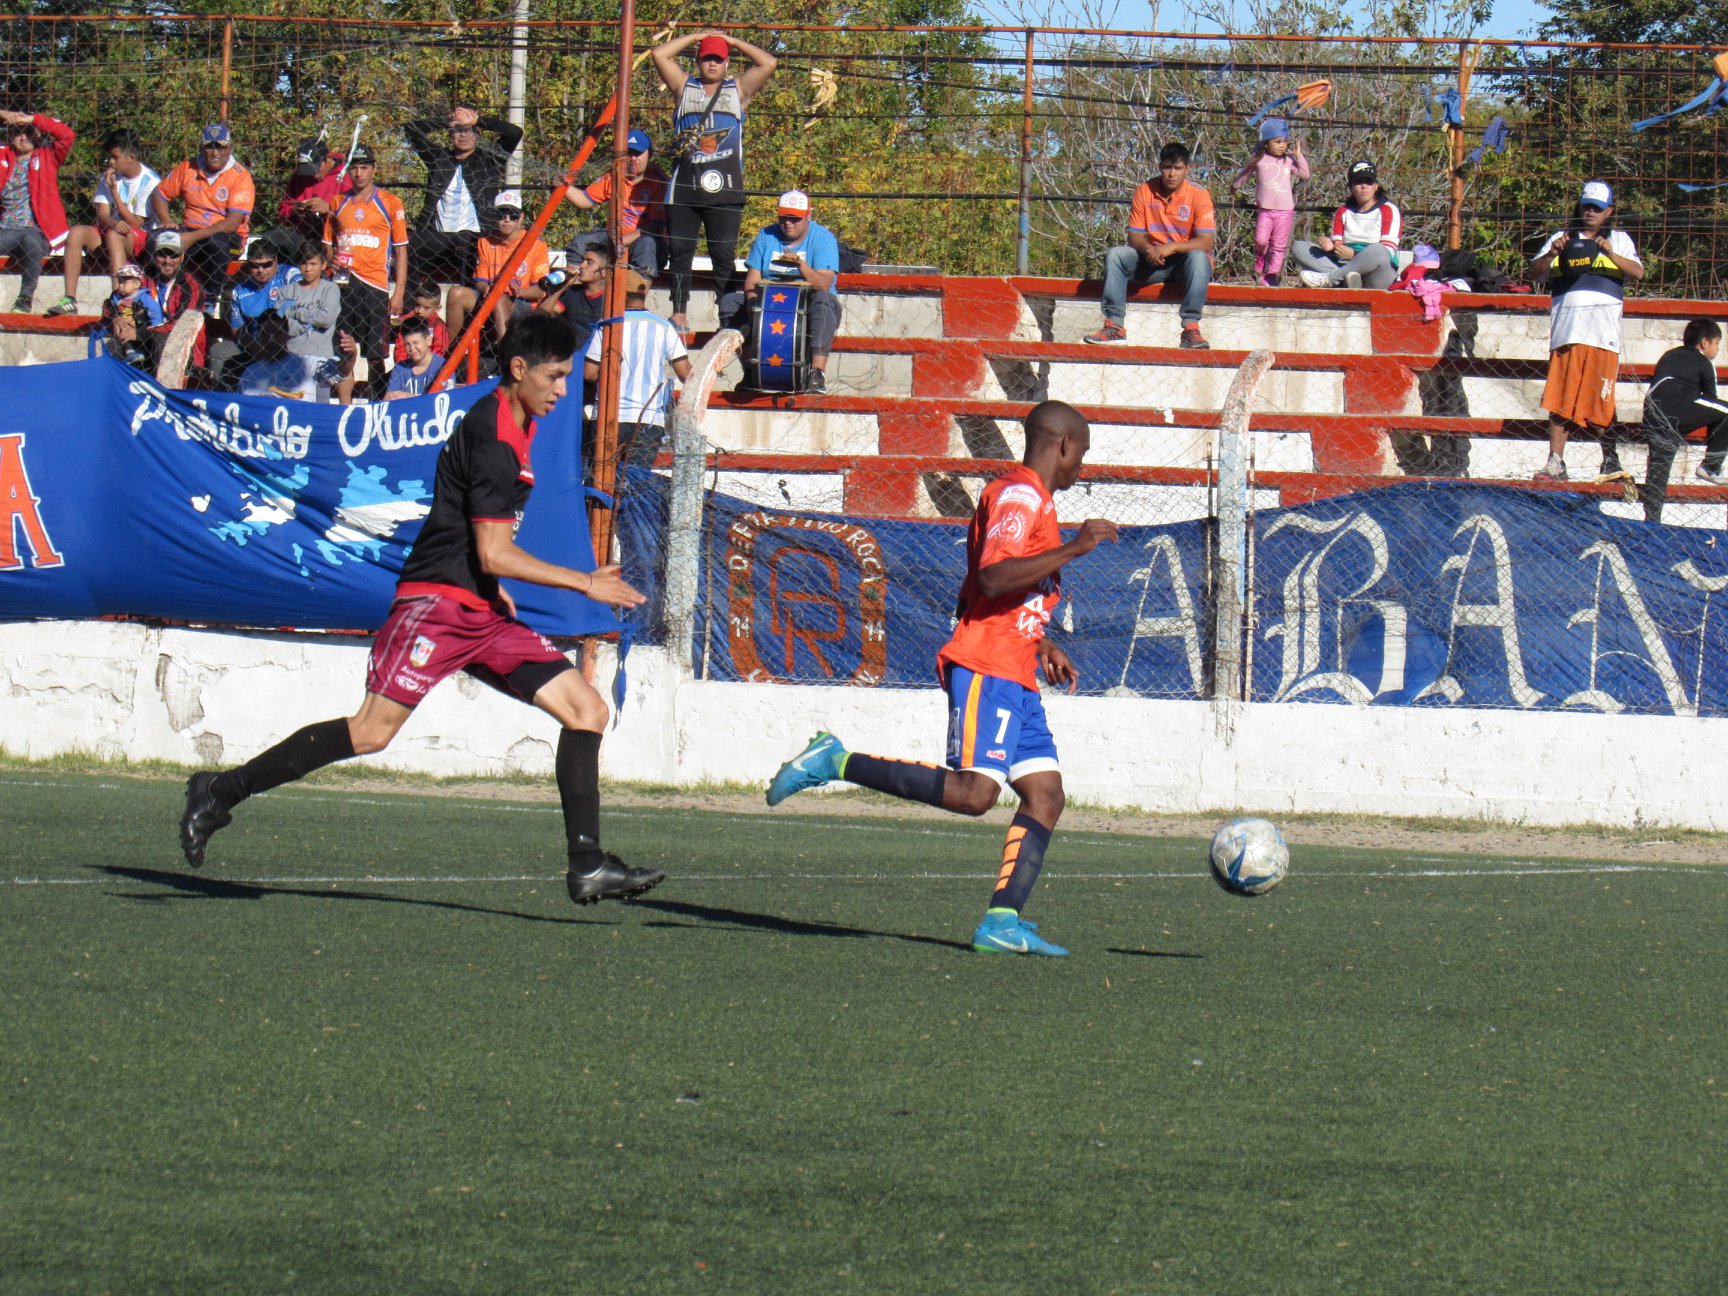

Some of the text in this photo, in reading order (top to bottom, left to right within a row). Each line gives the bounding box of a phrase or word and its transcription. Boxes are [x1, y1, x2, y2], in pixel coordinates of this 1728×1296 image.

[1568, 257, 1591, 267] BOCA
[730, 616, 750, 639] 14
[994, 708, 1012, 745] 7
